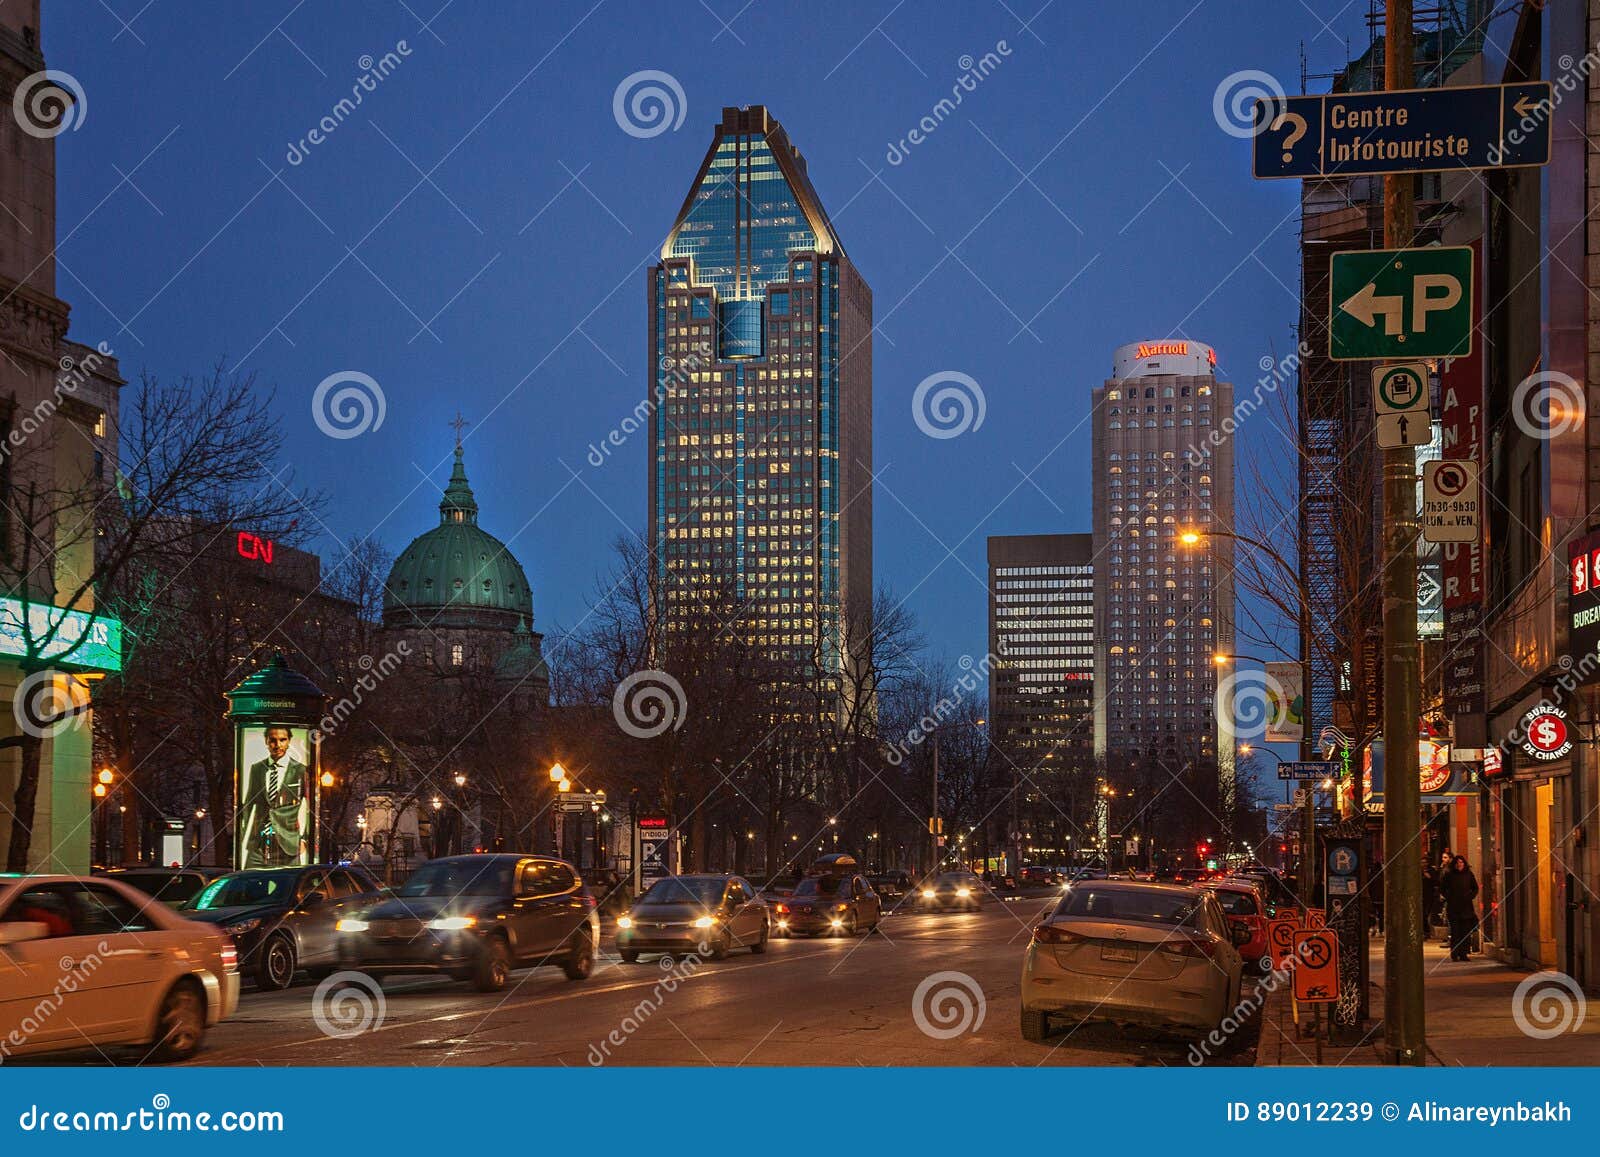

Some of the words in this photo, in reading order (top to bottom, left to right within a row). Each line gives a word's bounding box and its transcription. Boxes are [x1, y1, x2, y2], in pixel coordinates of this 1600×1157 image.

[1331, 104, 1408, 129] Centre
[1330, 133, 1469, 162] Infotouriste
[1412, 274, 1462, 333] P
[1136, 343, 1187, 360] Marriott
[1426, 501, 1476, 512] 7h30-9h30
[238, 531, 273, 564] CN
[1573, 605, 1600, 629] BUREA
[1526, 706, 1567, 720] BUREAU
[1523, 743, 1534, 756] DE
[1535, 741, 1572, 760] CHANGE
[1420, 772, 1446, 790] VINCE
